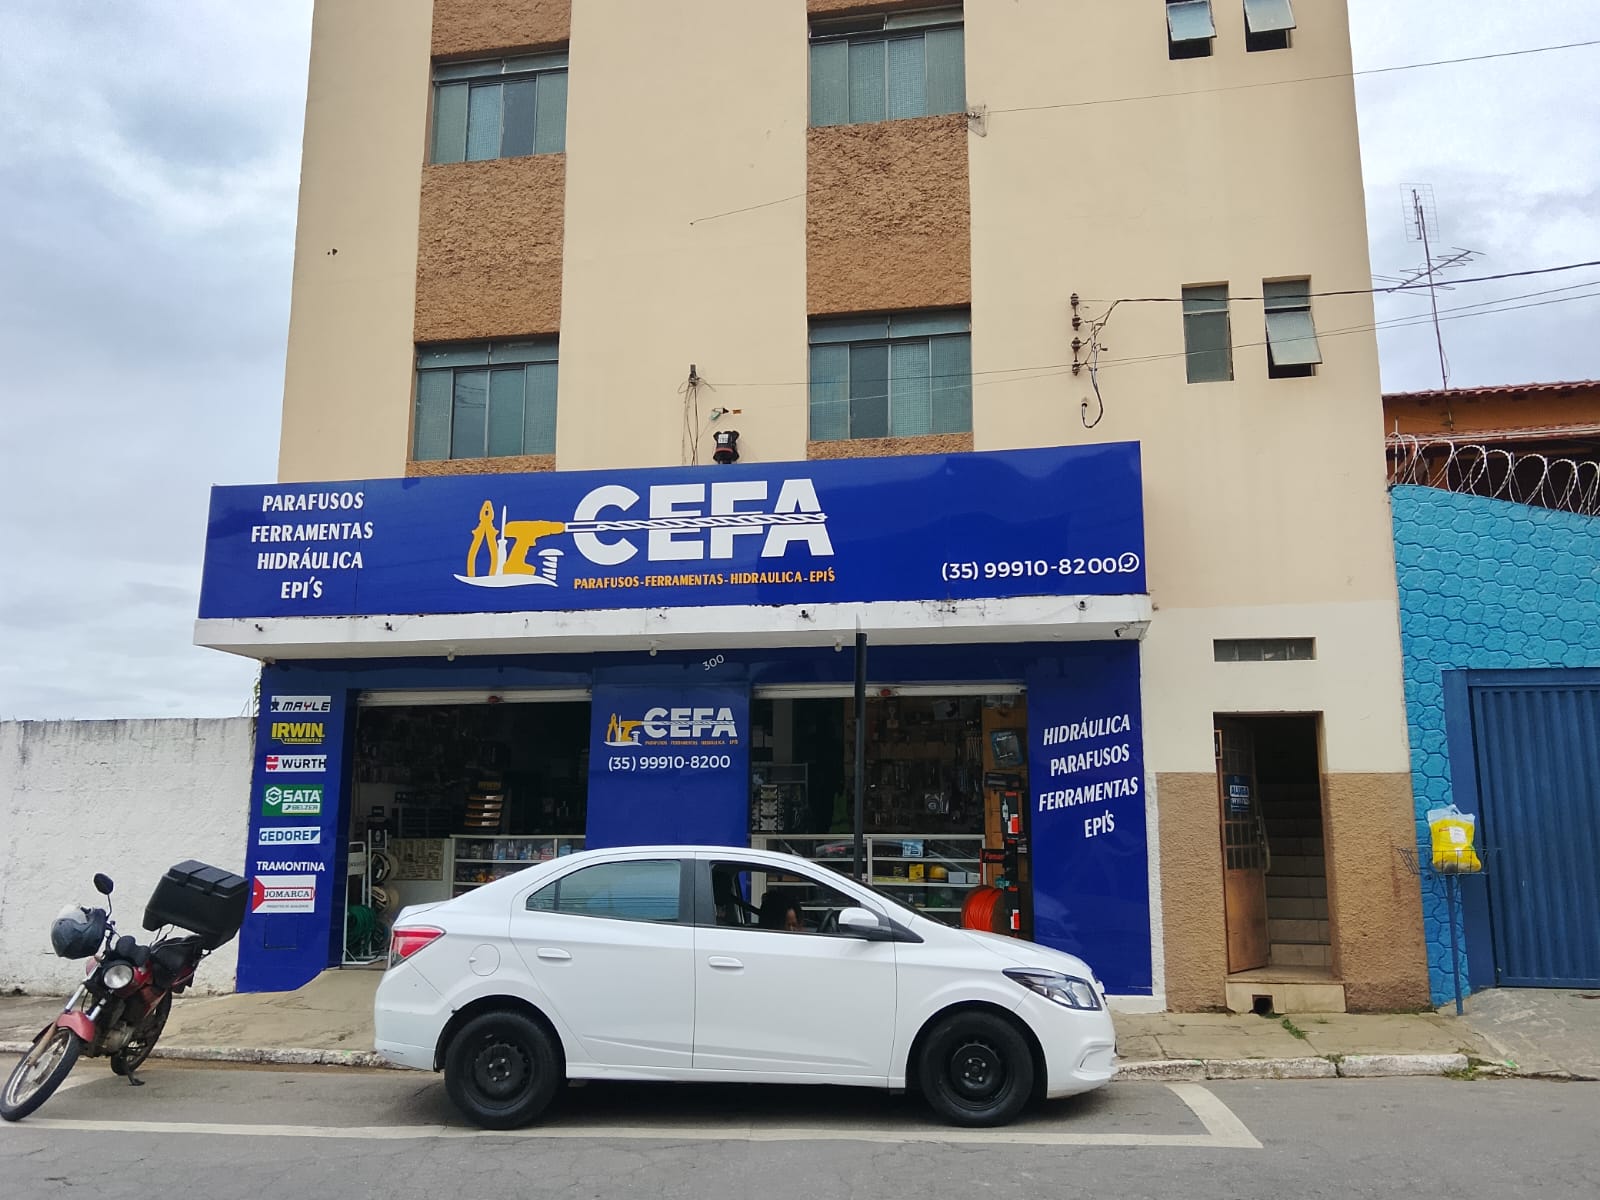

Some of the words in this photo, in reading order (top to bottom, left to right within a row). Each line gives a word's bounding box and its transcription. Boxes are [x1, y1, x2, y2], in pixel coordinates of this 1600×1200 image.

[262, 491, 365, 512] PARAFUSOS
[573, 478, 835, 566] CEFA
[251, 521, 374, 543] FERRAMENTAS
[257, 547, 363, 570] HIDRÁULICA
[942, 561, 979, 582] (35)
[984, 557, 1117, 579] 99910-8200
[702, 654, 725, 671] 300
[282, 701, 331, 712] MAYLE
[271, 722, 325, 738] IRWIN
[643, 707, 738, 739] CEFA
[1043, 714, 1131, 746] HIDRÁULICA
[281, 757, 326, 769] WÜRTH
[608, 756, 636, 772] (35)
[639, 755, 731, 769] 99910-8200
[1050, 743, 1130, 777] PARAFUSOS
[283, 789, 321, 802] SATA
[1038, 776, 1139, 812] FERRAMENTAS
[260, 830, 310, 842] GEDORE
[256, 861, 326, 872] TRAMONTINA
[264, 890, 310, 898] JOMARCA
